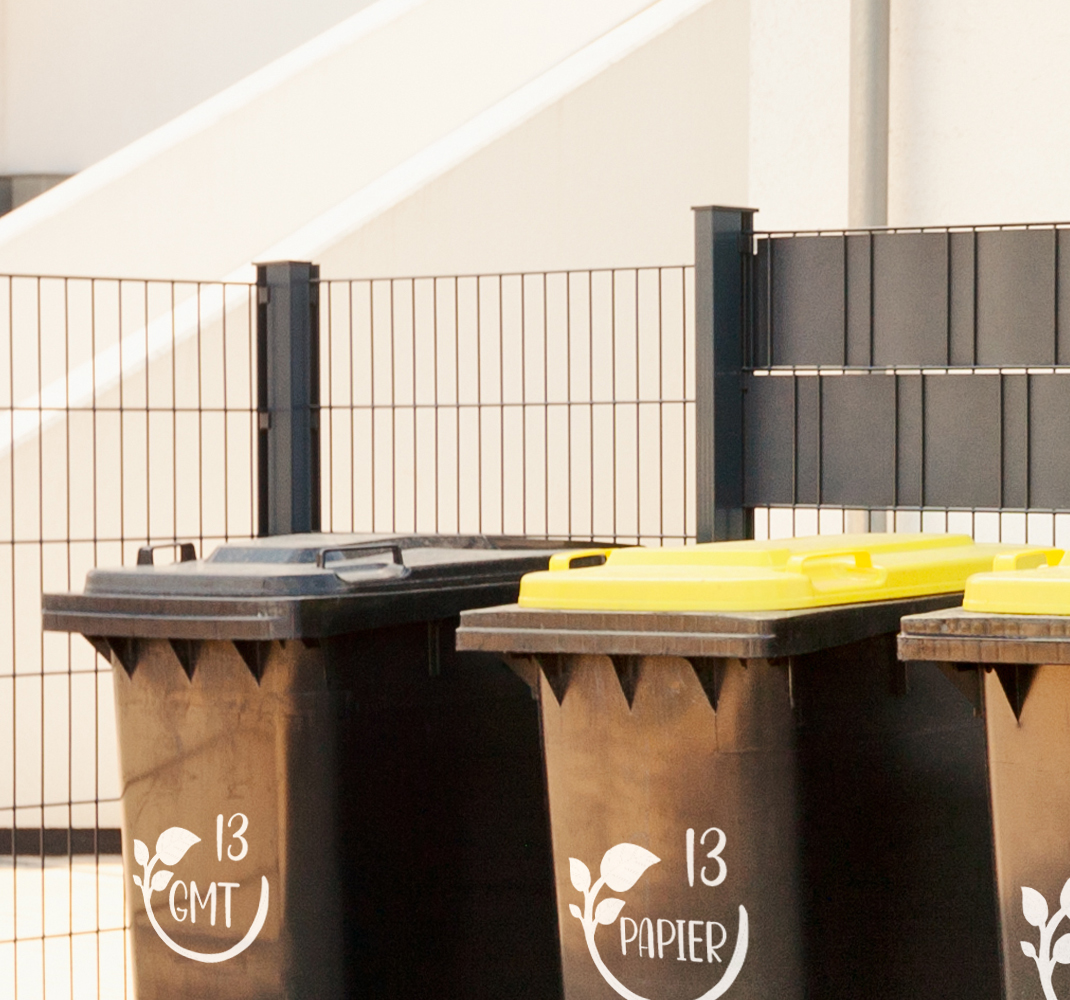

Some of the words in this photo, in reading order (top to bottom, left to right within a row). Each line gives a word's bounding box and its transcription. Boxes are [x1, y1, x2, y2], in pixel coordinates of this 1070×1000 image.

[217, 813, 248, 861] 13
[686, 827, 727, 886] 13
[169, 880, 241, 929] GMT
[620, 917, 727, 963] PAPIER
